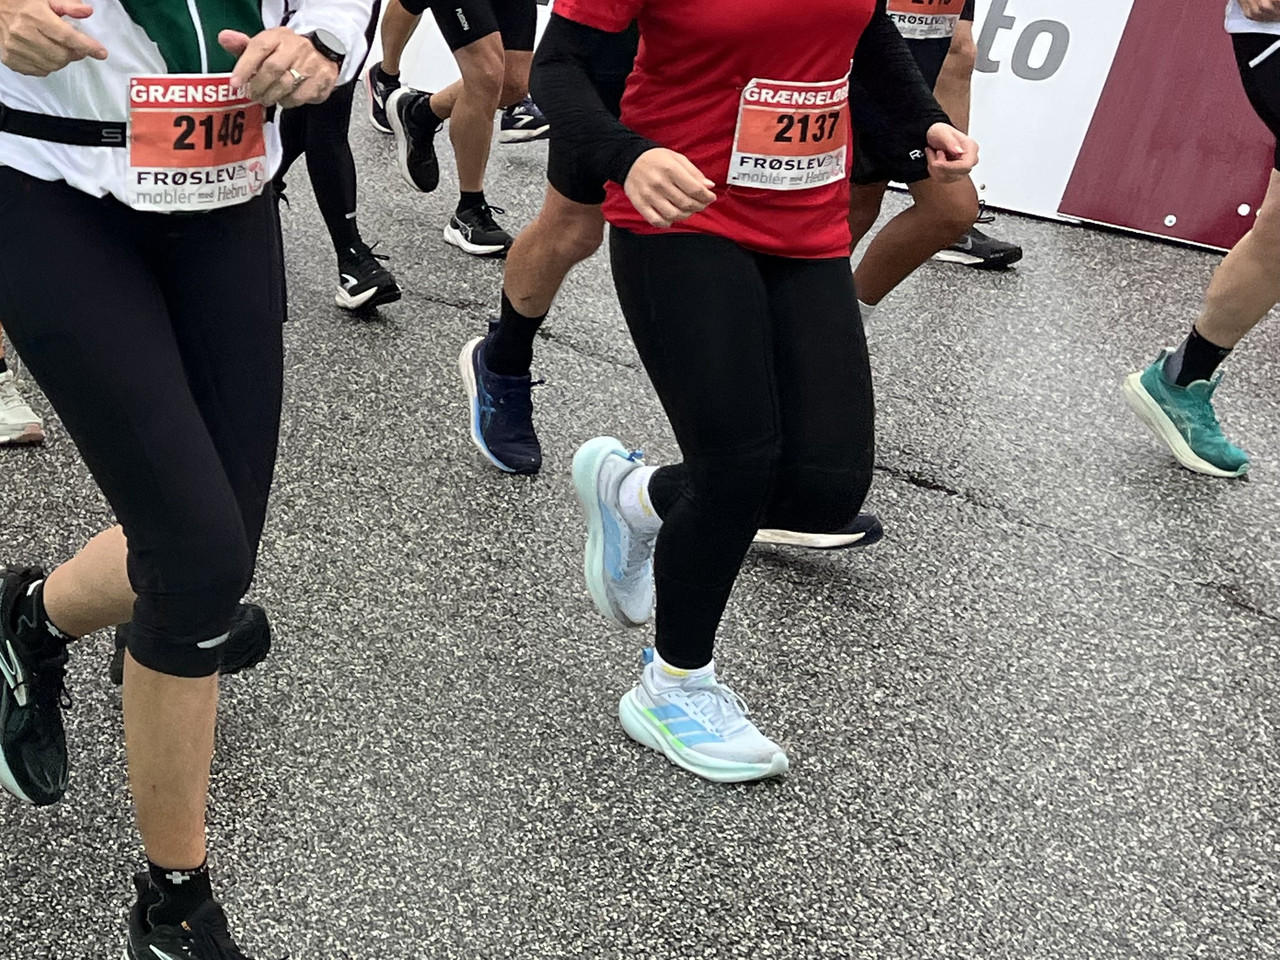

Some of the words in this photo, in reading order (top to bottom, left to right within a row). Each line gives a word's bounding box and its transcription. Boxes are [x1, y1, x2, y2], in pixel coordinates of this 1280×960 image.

[173, 110, 247, 151] 2146
[773, 110, 840, 143] 2137
[739, 155, 826, 171] FRØSLEV
[137, 165, 236, 186] FRØSLEV
[217, 183, 248, 202] Hebru
